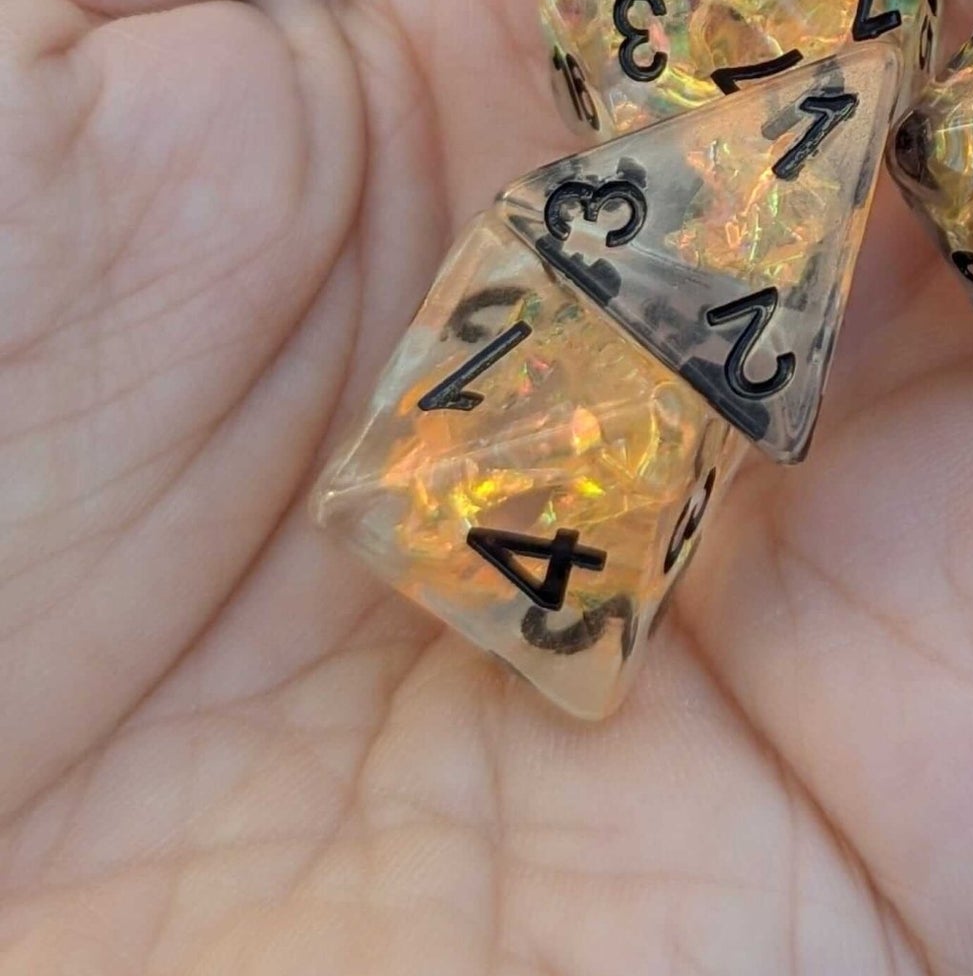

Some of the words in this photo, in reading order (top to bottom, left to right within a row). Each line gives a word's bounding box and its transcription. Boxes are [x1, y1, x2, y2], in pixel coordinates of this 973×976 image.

[772, 93, 859, 181] 1
[544, 180, 648, 247] 3
[418, 320, 532, 411] 1
[706, 287, 796, 399] 2
[466, 527, 608, 611] 4
